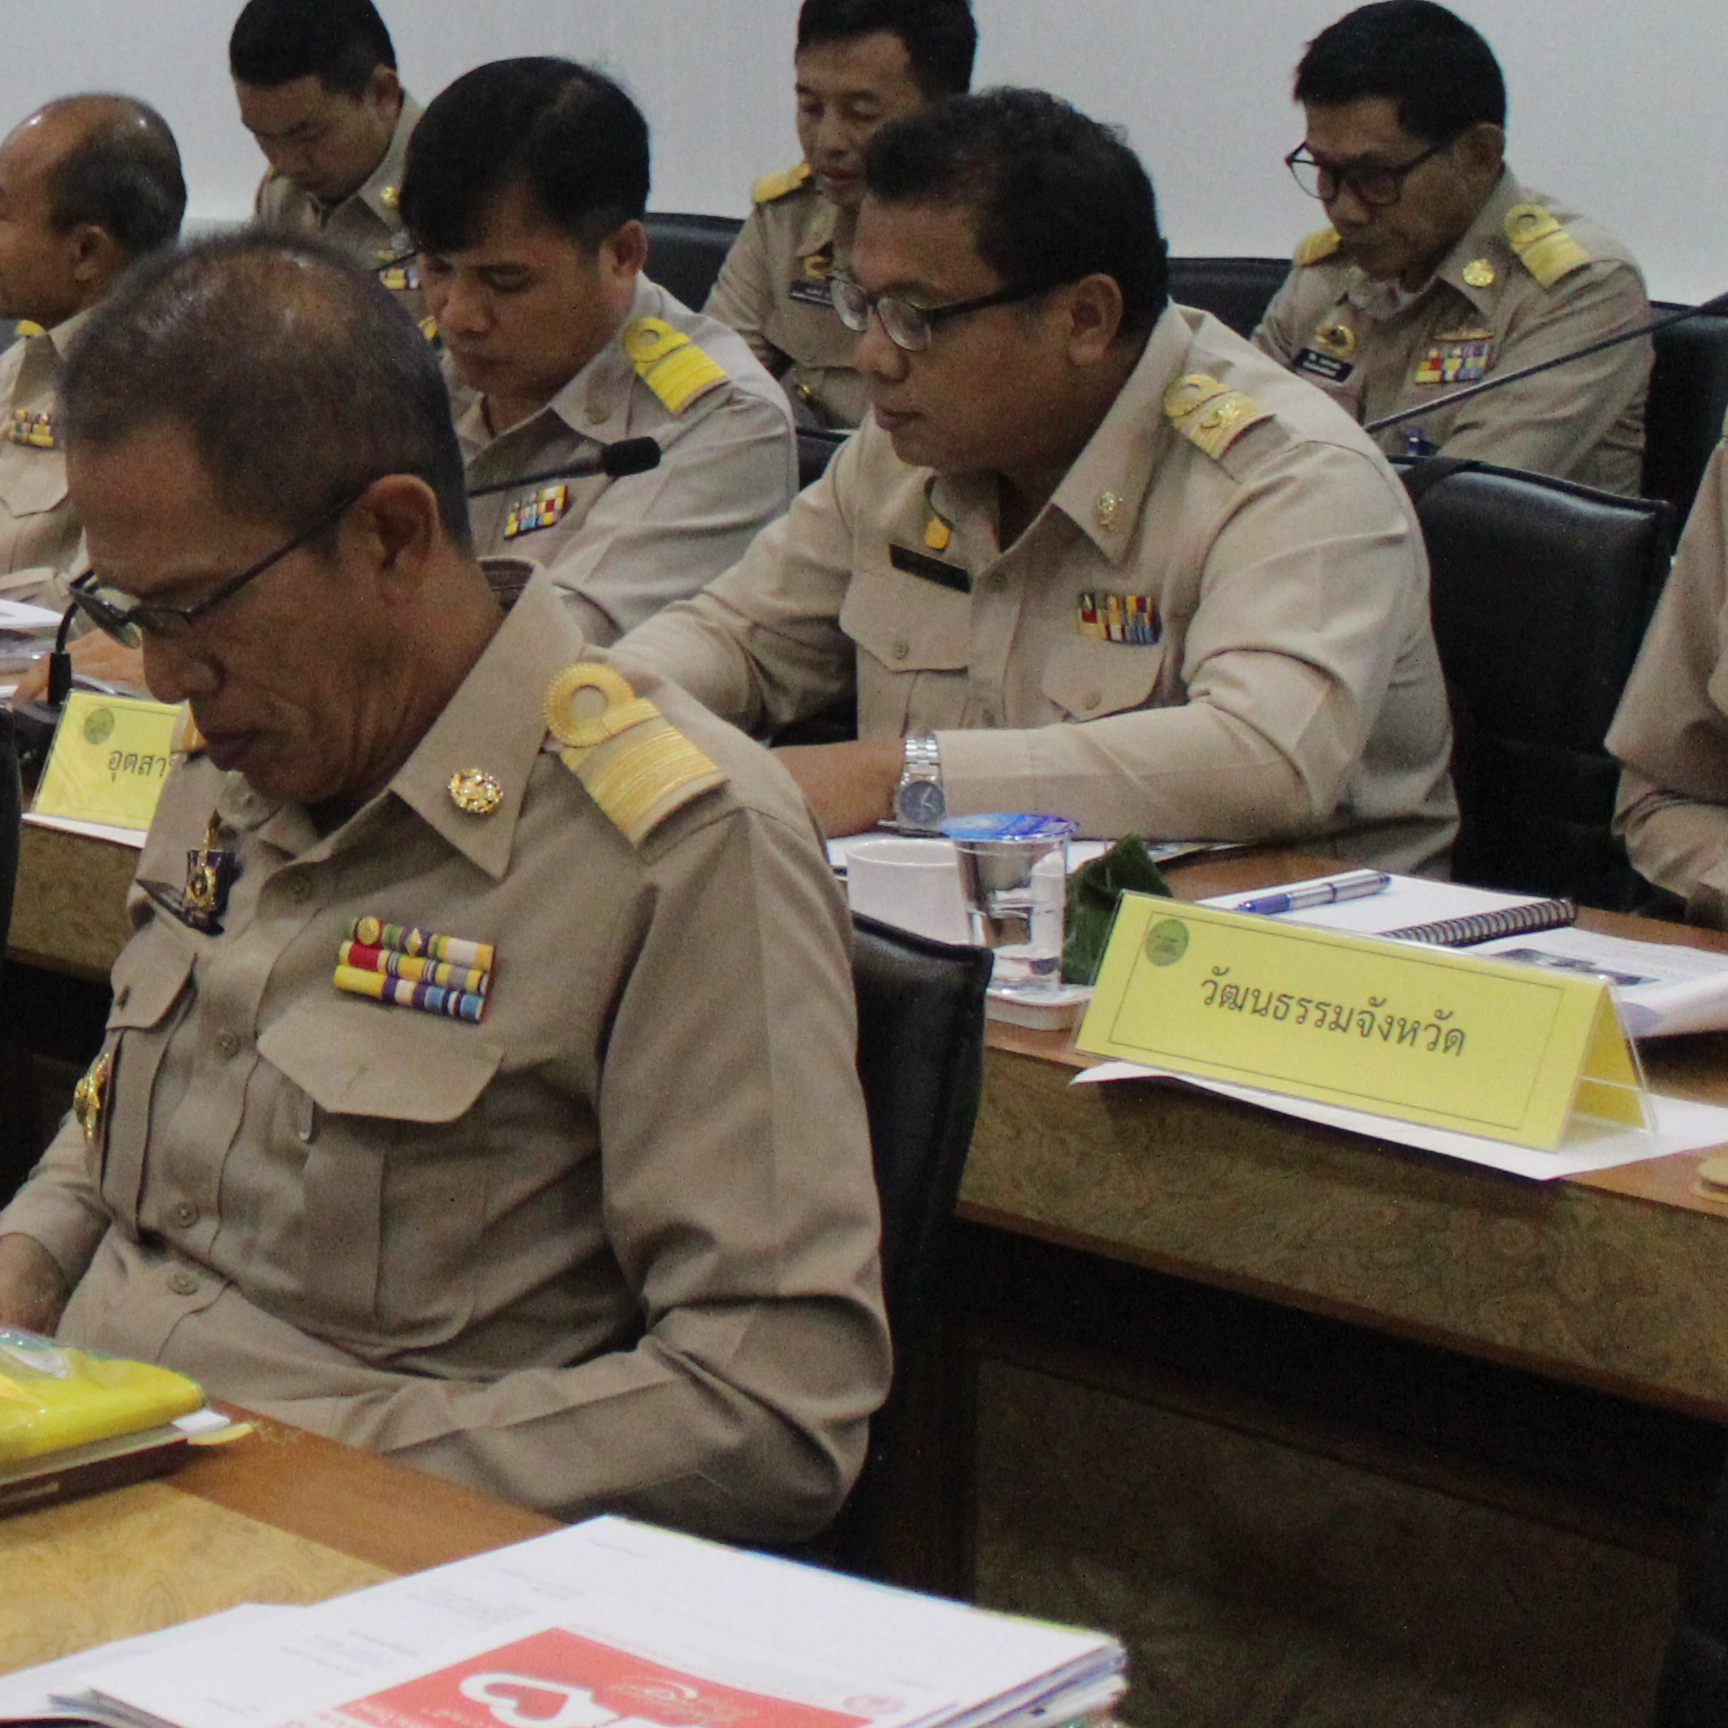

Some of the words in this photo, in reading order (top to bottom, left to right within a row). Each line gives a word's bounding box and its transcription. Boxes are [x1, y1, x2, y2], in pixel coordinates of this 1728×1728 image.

[1200, 965, 1466, 1058] วัฒนธรรมจังหวัด
